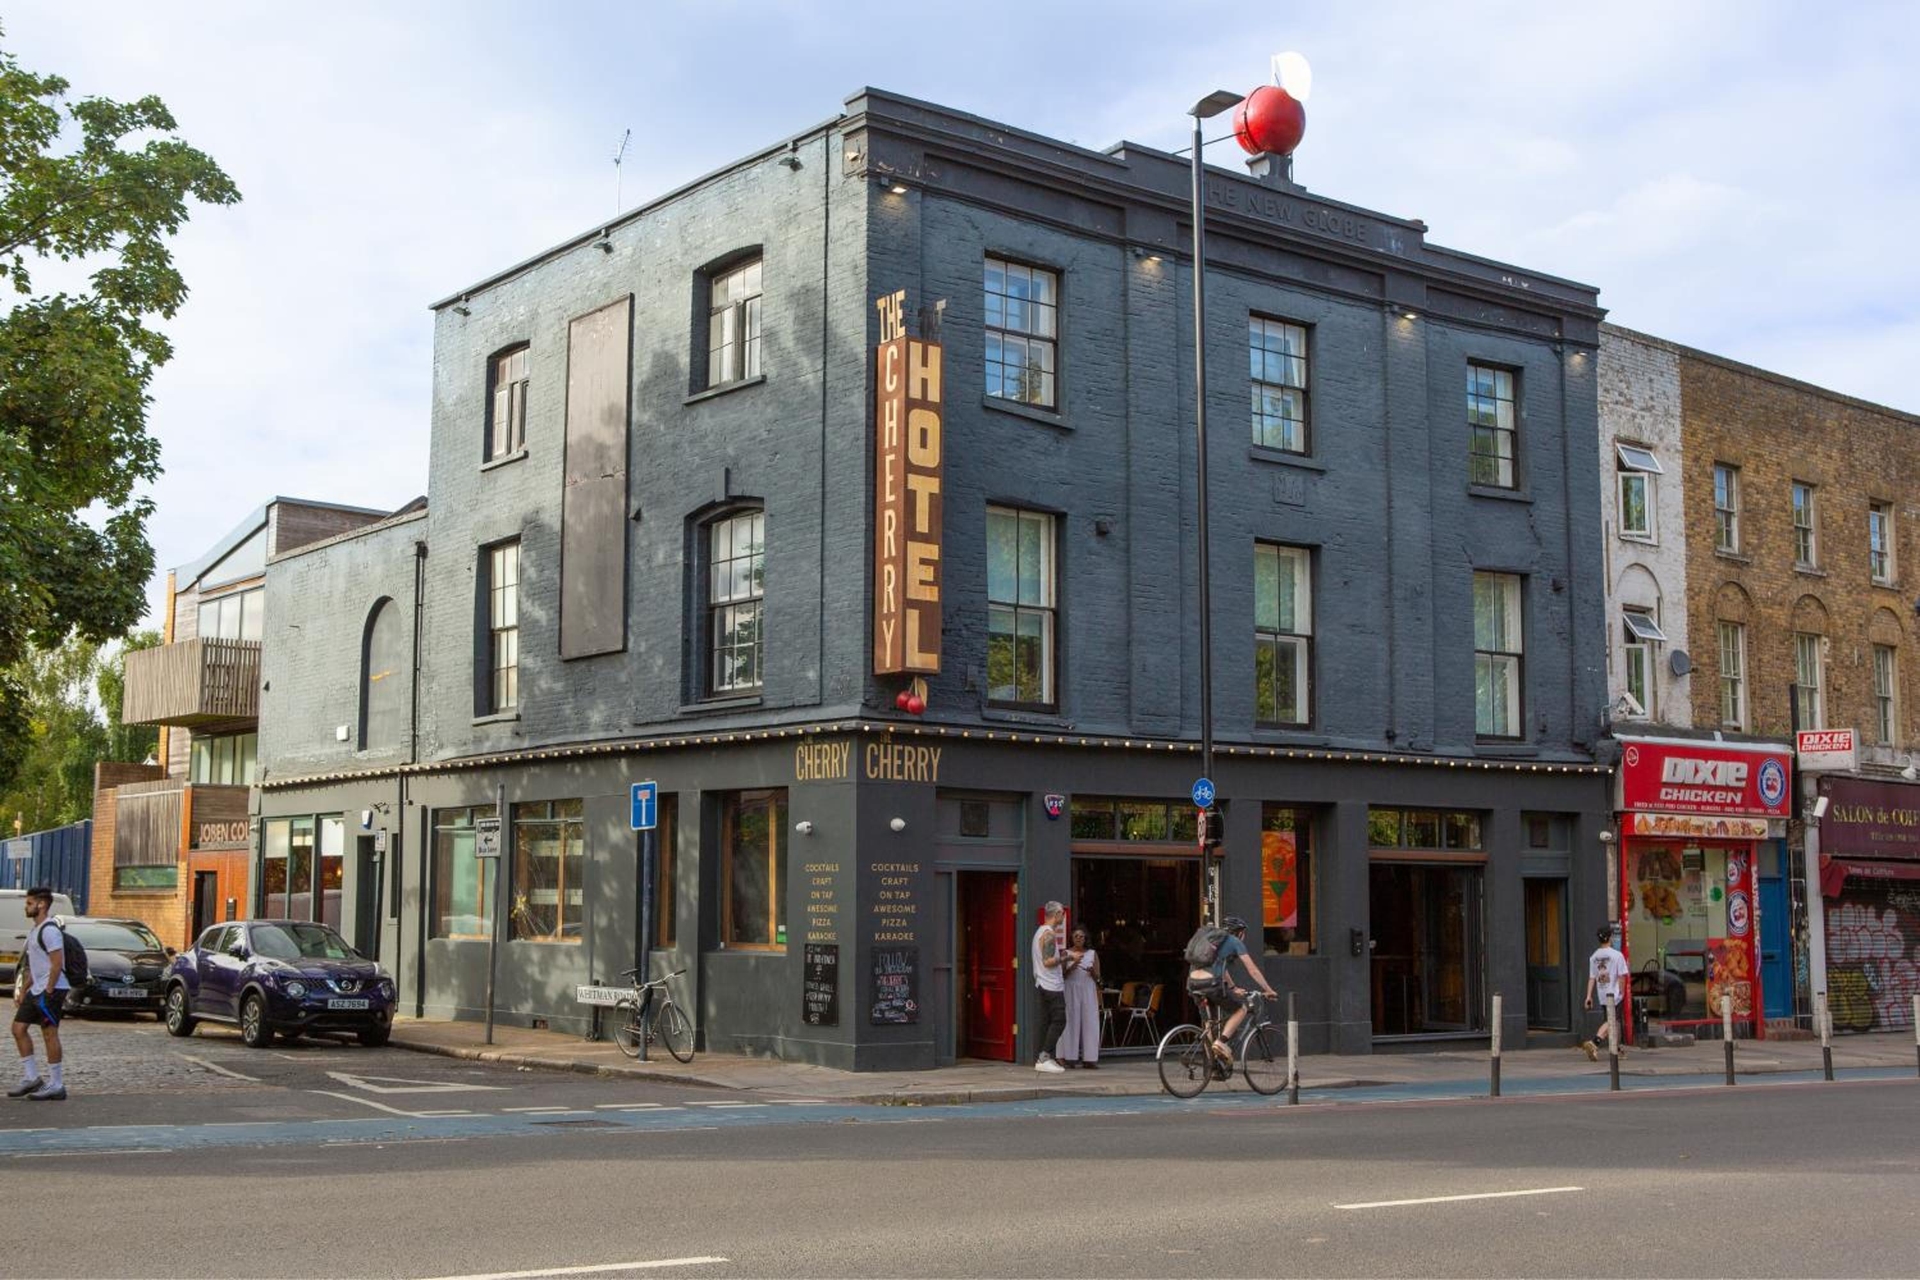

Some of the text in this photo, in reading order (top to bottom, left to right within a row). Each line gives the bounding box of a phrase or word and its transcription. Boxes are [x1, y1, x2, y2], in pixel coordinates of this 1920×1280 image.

[1247, 188, 1292, 222] NEW
[1302, 207, 1366, 242] GLOBE
[877, 289, 906, 344] THE
[882, 345, 899, 669] CHERRY
[905, 340, 941, 670] HOTEL
[795, 741, 850, 781] CHERRY
[866, 742, 941, 782] CHERRY
[1833, 804, 1873, 823] SALON
[1877, 807, 1889, 824] de
[805, 863, 840, 873] COCKTAILS
[871, 863, 919, 873] COCKTAILS
[812, 877, 832, 886] CRAFT
[881, 877, 908, 886] CRAFT
[811, 890, 834, 899] ON TAP
[880, 890, 911, 899] ON TAP
[807, 904, 838, 913] AWESOME
[873, 904, 917, 914] AWESOME
[812, 917, 832, 927] PIZZA
[881, 918, 908, 927] PIZZA
[807, 931, 837, 941] KARAOKE
[874, 932, 915, 941] KARAOKE
[578, 988, 613, 1001] WHITMAN
